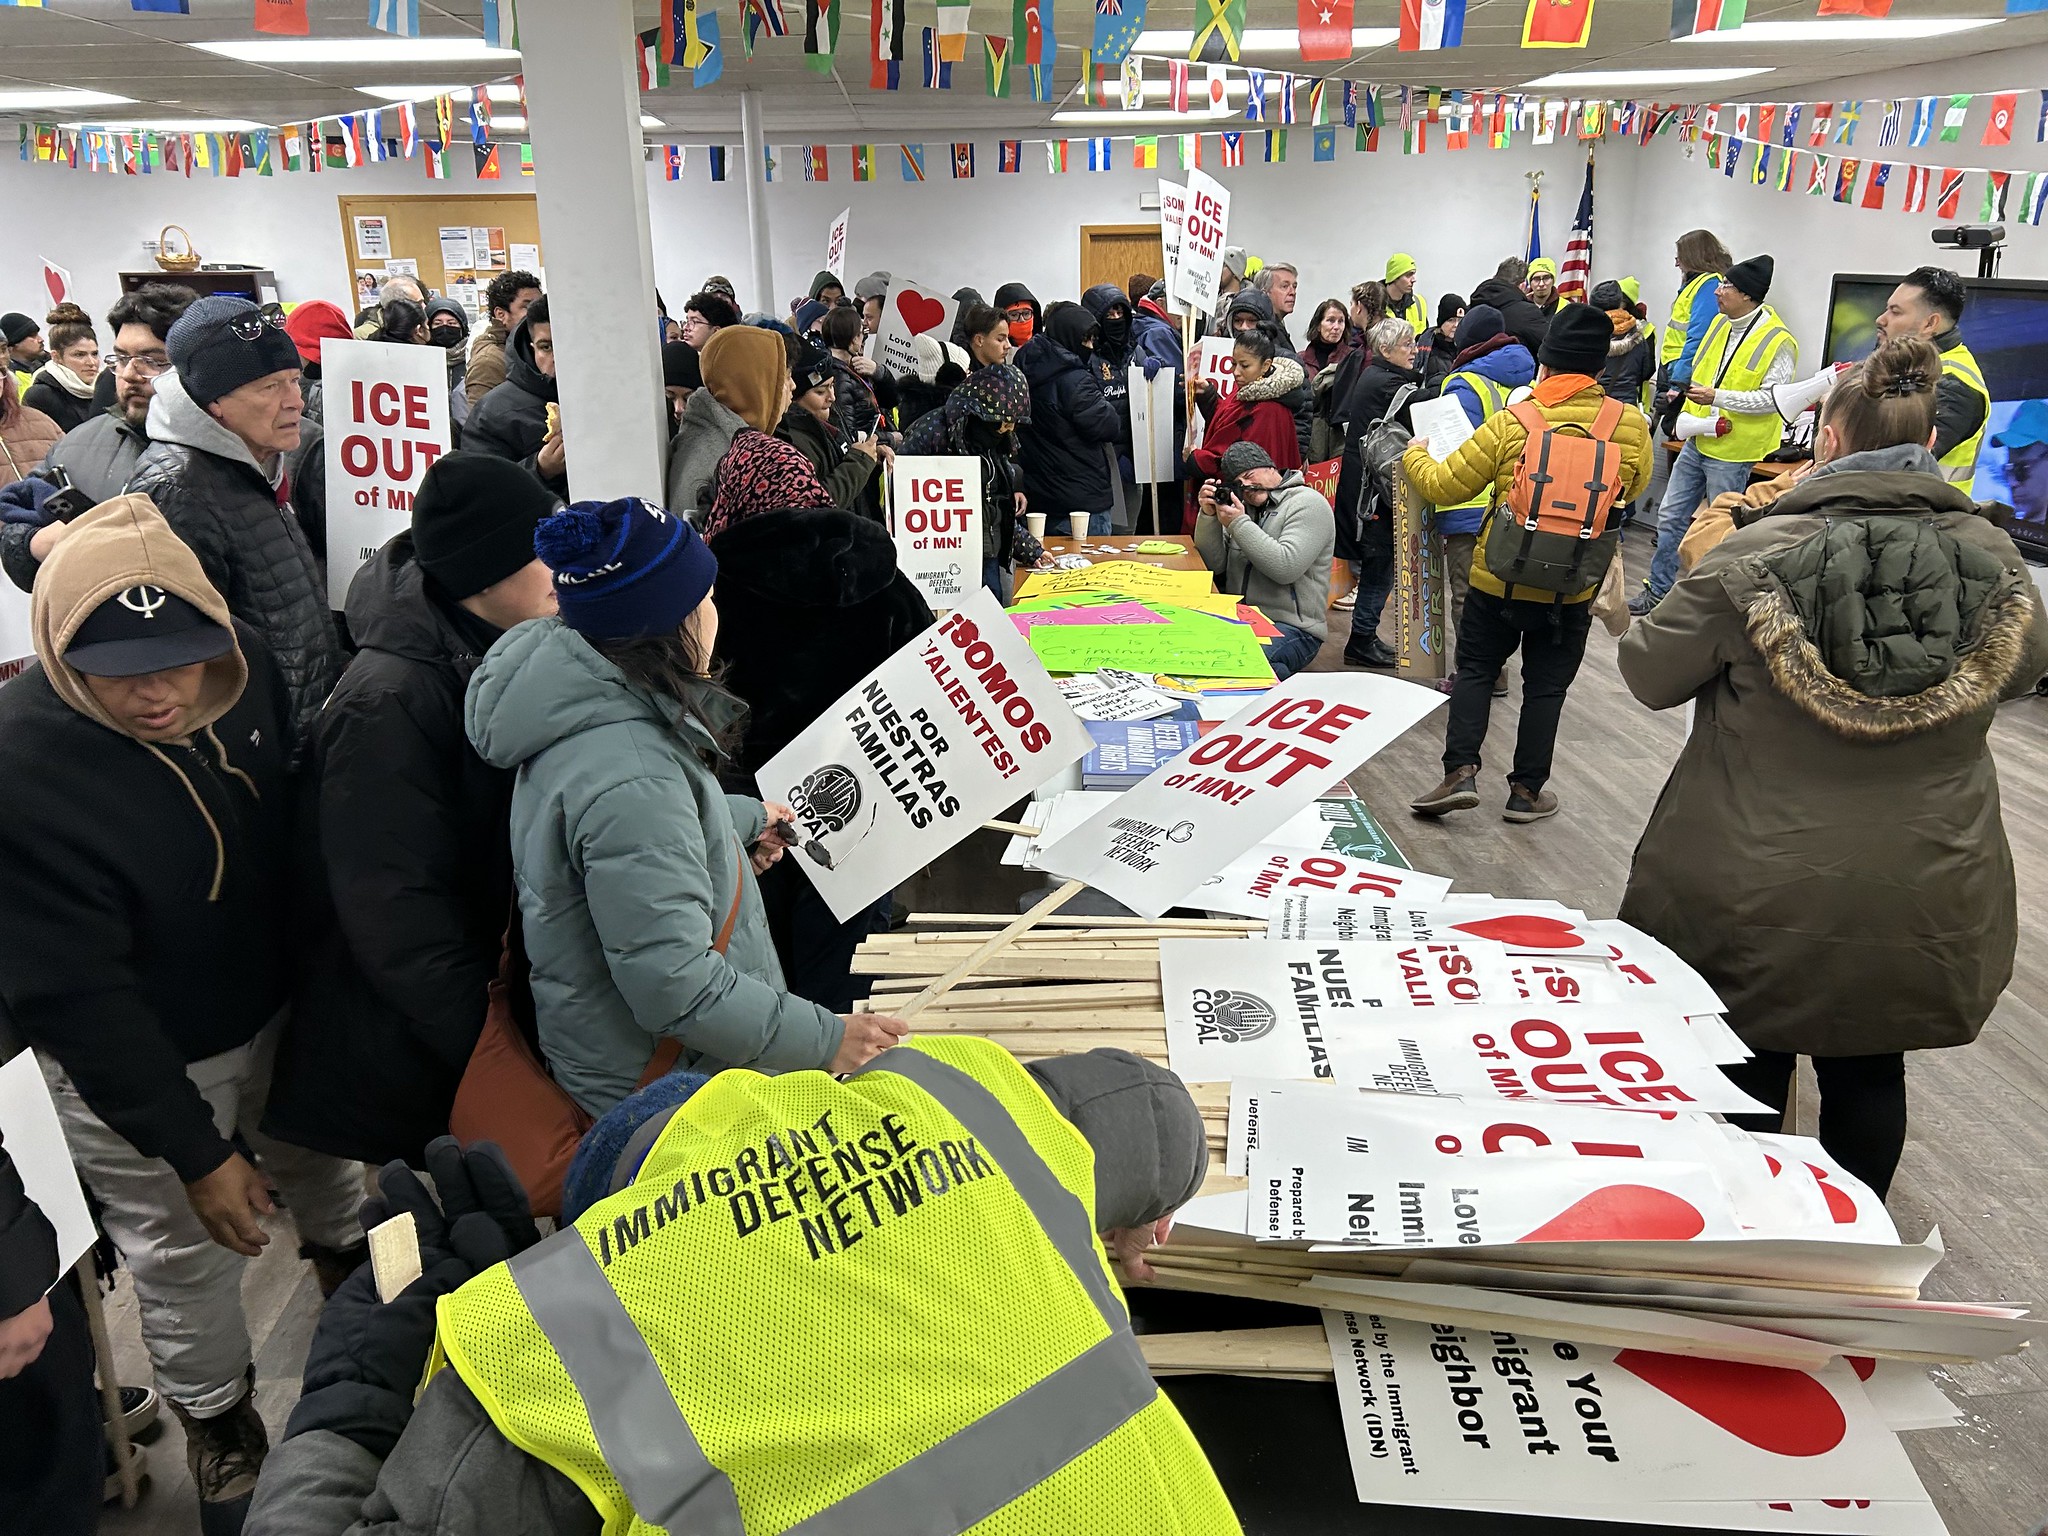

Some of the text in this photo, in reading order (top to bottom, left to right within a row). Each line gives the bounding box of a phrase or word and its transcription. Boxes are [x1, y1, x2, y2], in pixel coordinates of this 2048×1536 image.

[1163, 195, 1185, 212] ¡SOM
[1195, 190, 1222, 225] ICE
[829, 236, 844, 260] OUT
[831, 222, 844, 243] ICE
[1187, 215, 1223, 250] OUT
[1189, 241, 1198, 252] of
[1199, 244, 1216, 262] MN!
[888, 333, 912, 349] Love
[885, 358, 918, 377] Neighb
[1209, 354, 1234, 375] IC
[351, 380, 430, 430] ICE
[1103, 385, 1127, 398] Ralph
[340, 434, 442, 482] OUT
[354, 486, 380, 507] of
[911, 478, 965, 503] ICE
[904, 508, 973, 533] OUT
[912, 537, 962, 550] of MN!
[915, 571, 948, 580] IMMIGRANT
[928, 579, 953, 588] DEFENSE
[933, 586, 962, 595] NETWORK
[1398, 479, 1412, 668] Immigrants
[1418, 506, 1431, 656] America
[1429, 504, 1443, 655] GREA
[1041, 645, 1154, 657] Criminal
[937, 613, 1053, 754] ¡SOMOS
[1093, 699, 1144, 716] POLICE
[1246, 697, 1372, 744] ICE
[861, 679, 961, 819] NUESTRAS
[909, 707, 951, 758] POR
[1126, 726, 1157, 768] IMMIGRANT
[1153, 723, 1182, 750] DEFEND
[845, 706, 934, 829] FAMILIAS
[1099, 744, 1128, 771] RIGHTS
[1188, 734, 1333, 788] OUT
[1163, 772, 1256, 806] of MN!
[1107, 816, 1165, 845] IMMIGRANT
[1110, 832, 1162, 856] DEFENSE
[1103, 845, 1160, 874] NETWORK
[1247, 855, 1290, 898] of MN!
[1287, 857, 1347, 889] OU
[1348, 871, 1403, 898] IC
[1370, 905, 1393, 941] Immigra
[1407, 910, 1428, 928] Love
[1412, 927, 1434, 941] Yo
[1427, 945, 1481, 1001] ¡SO
[1192, 988, 1219, 1045] COPAL
[1287, 962, 1335, 1078] FAMILIAS
[1472, 1033, 1511, 1060] of
[1388, 1063, 1418, 1094] DEFEN
[1398, 1038, 1439, 1095] IMMIGRANT
[1584, 1031, 1698, 1102] ICE
[598, 1108, 841, 1267] IMMIGRANT
[730, 1113, 918, 1239] DEFENSE
[799, 1138, 995, 1261] NETWORK
[1269, 1179, 1283, 1231] Defense
[1289, 1167, 1305, 1226] Prepared
[1451, 1188, 1482, 1245] Love
[1374, 1332, 1389, 1350] by
[1351, 1338, 1378, 1408] Network
[1379, 1351, 1396, 1378] the
[1430, 1322, 1491, 1450] eighbor
[1490, 1330, 1561, 1455] migrant
[1386, 1384, 1420, 1475] Immigrant
[1566, 1372, 1620, 1463] Your
[1362, 1412, 1389, 1459] (IDN)
